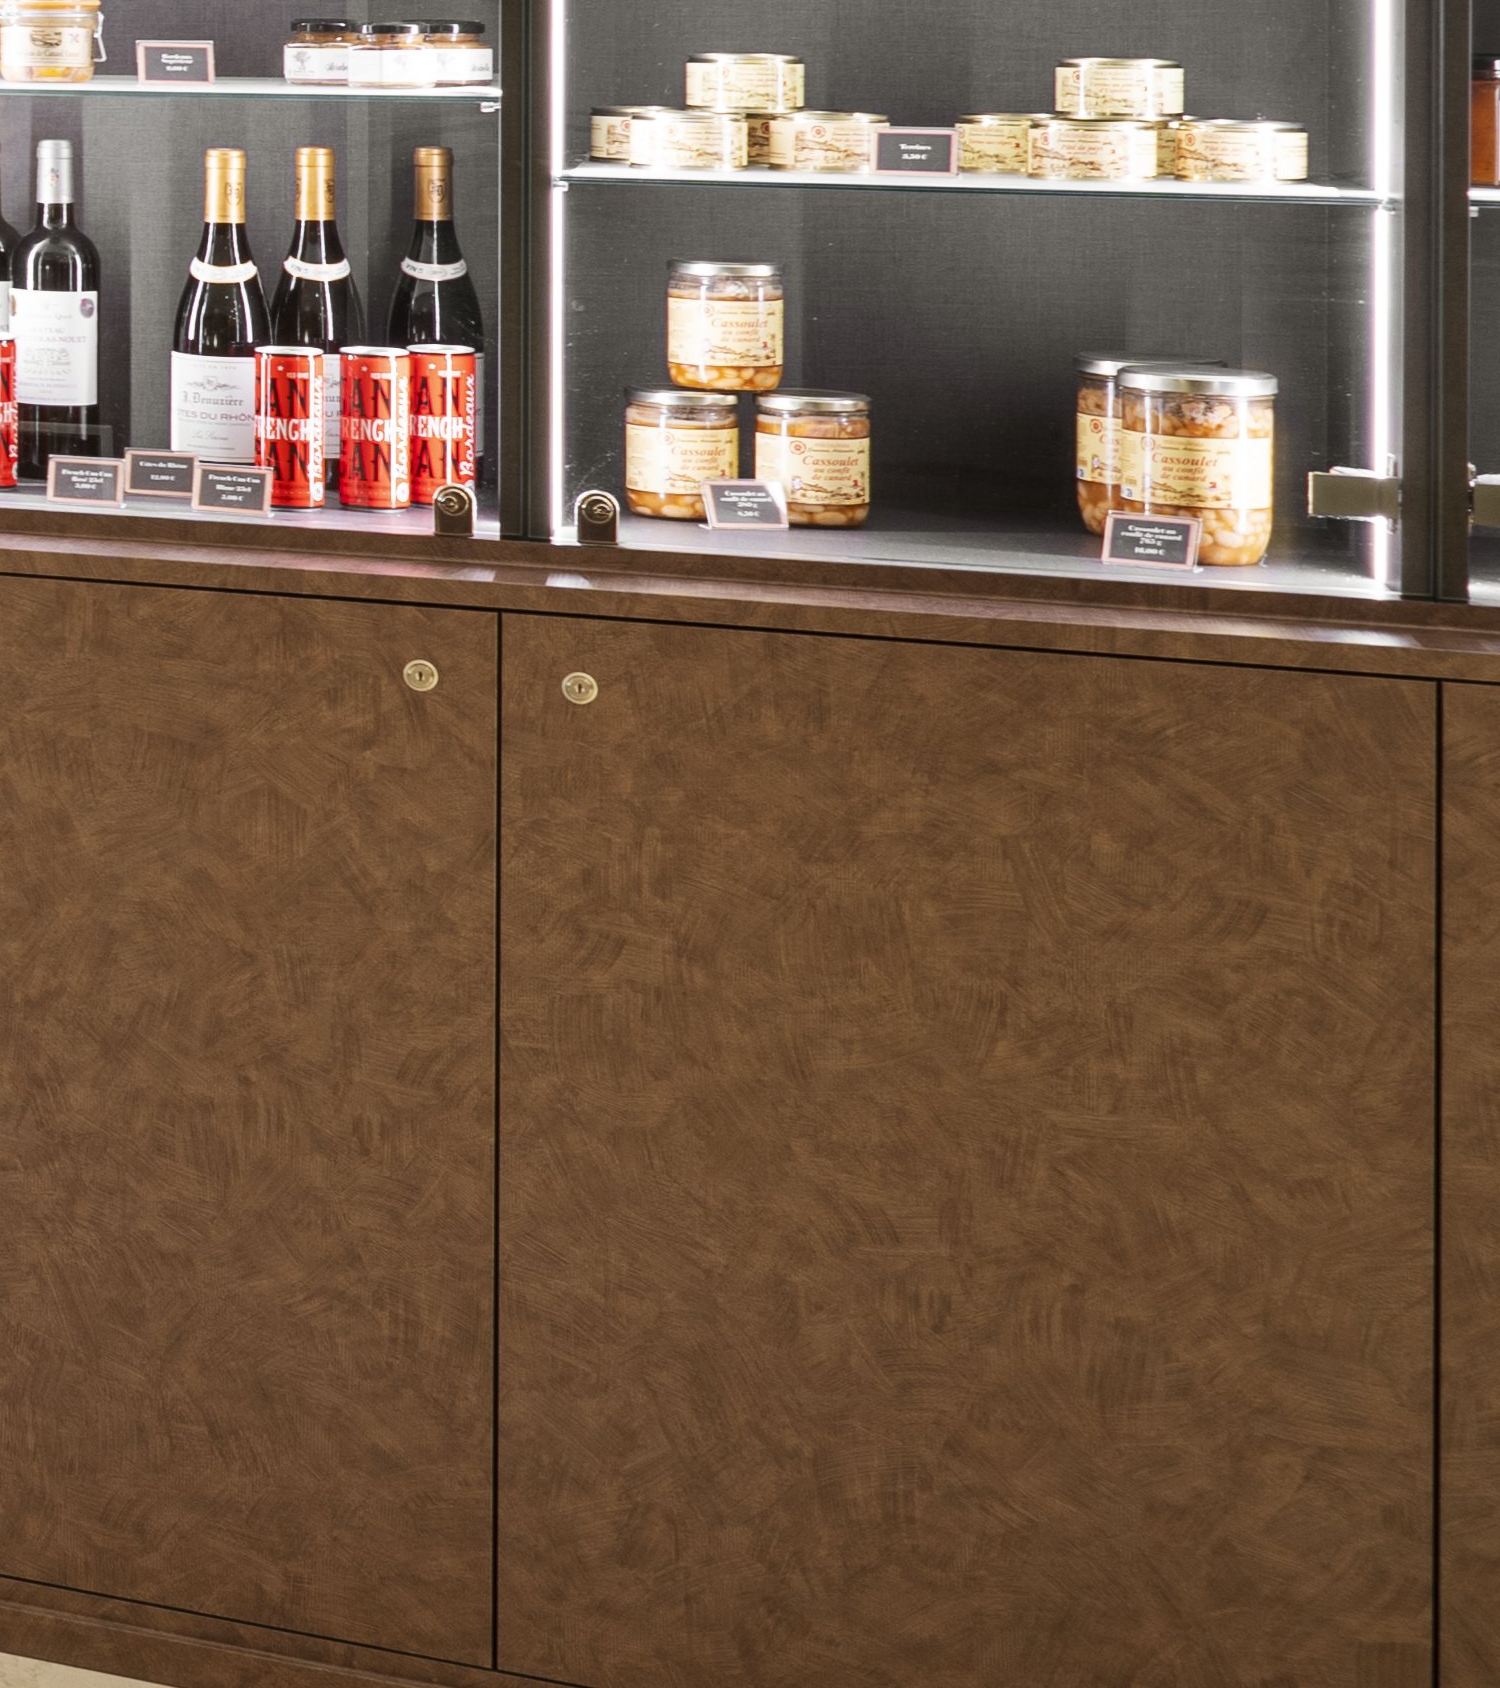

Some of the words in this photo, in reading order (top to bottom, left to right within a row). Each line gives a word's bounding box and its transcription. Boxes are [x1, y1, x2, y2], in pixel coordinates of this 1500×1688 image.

[711, 318, 768, 328] Cassoulet
[200, 411, 217, 421] DU
[220, 410, 255, 422] RHÔN
[671, 446, 726, 456] Cassoulet
[803, 456, 859, 466] Cassoulet
[1152, 454, 1218, 466] Cassoulet
